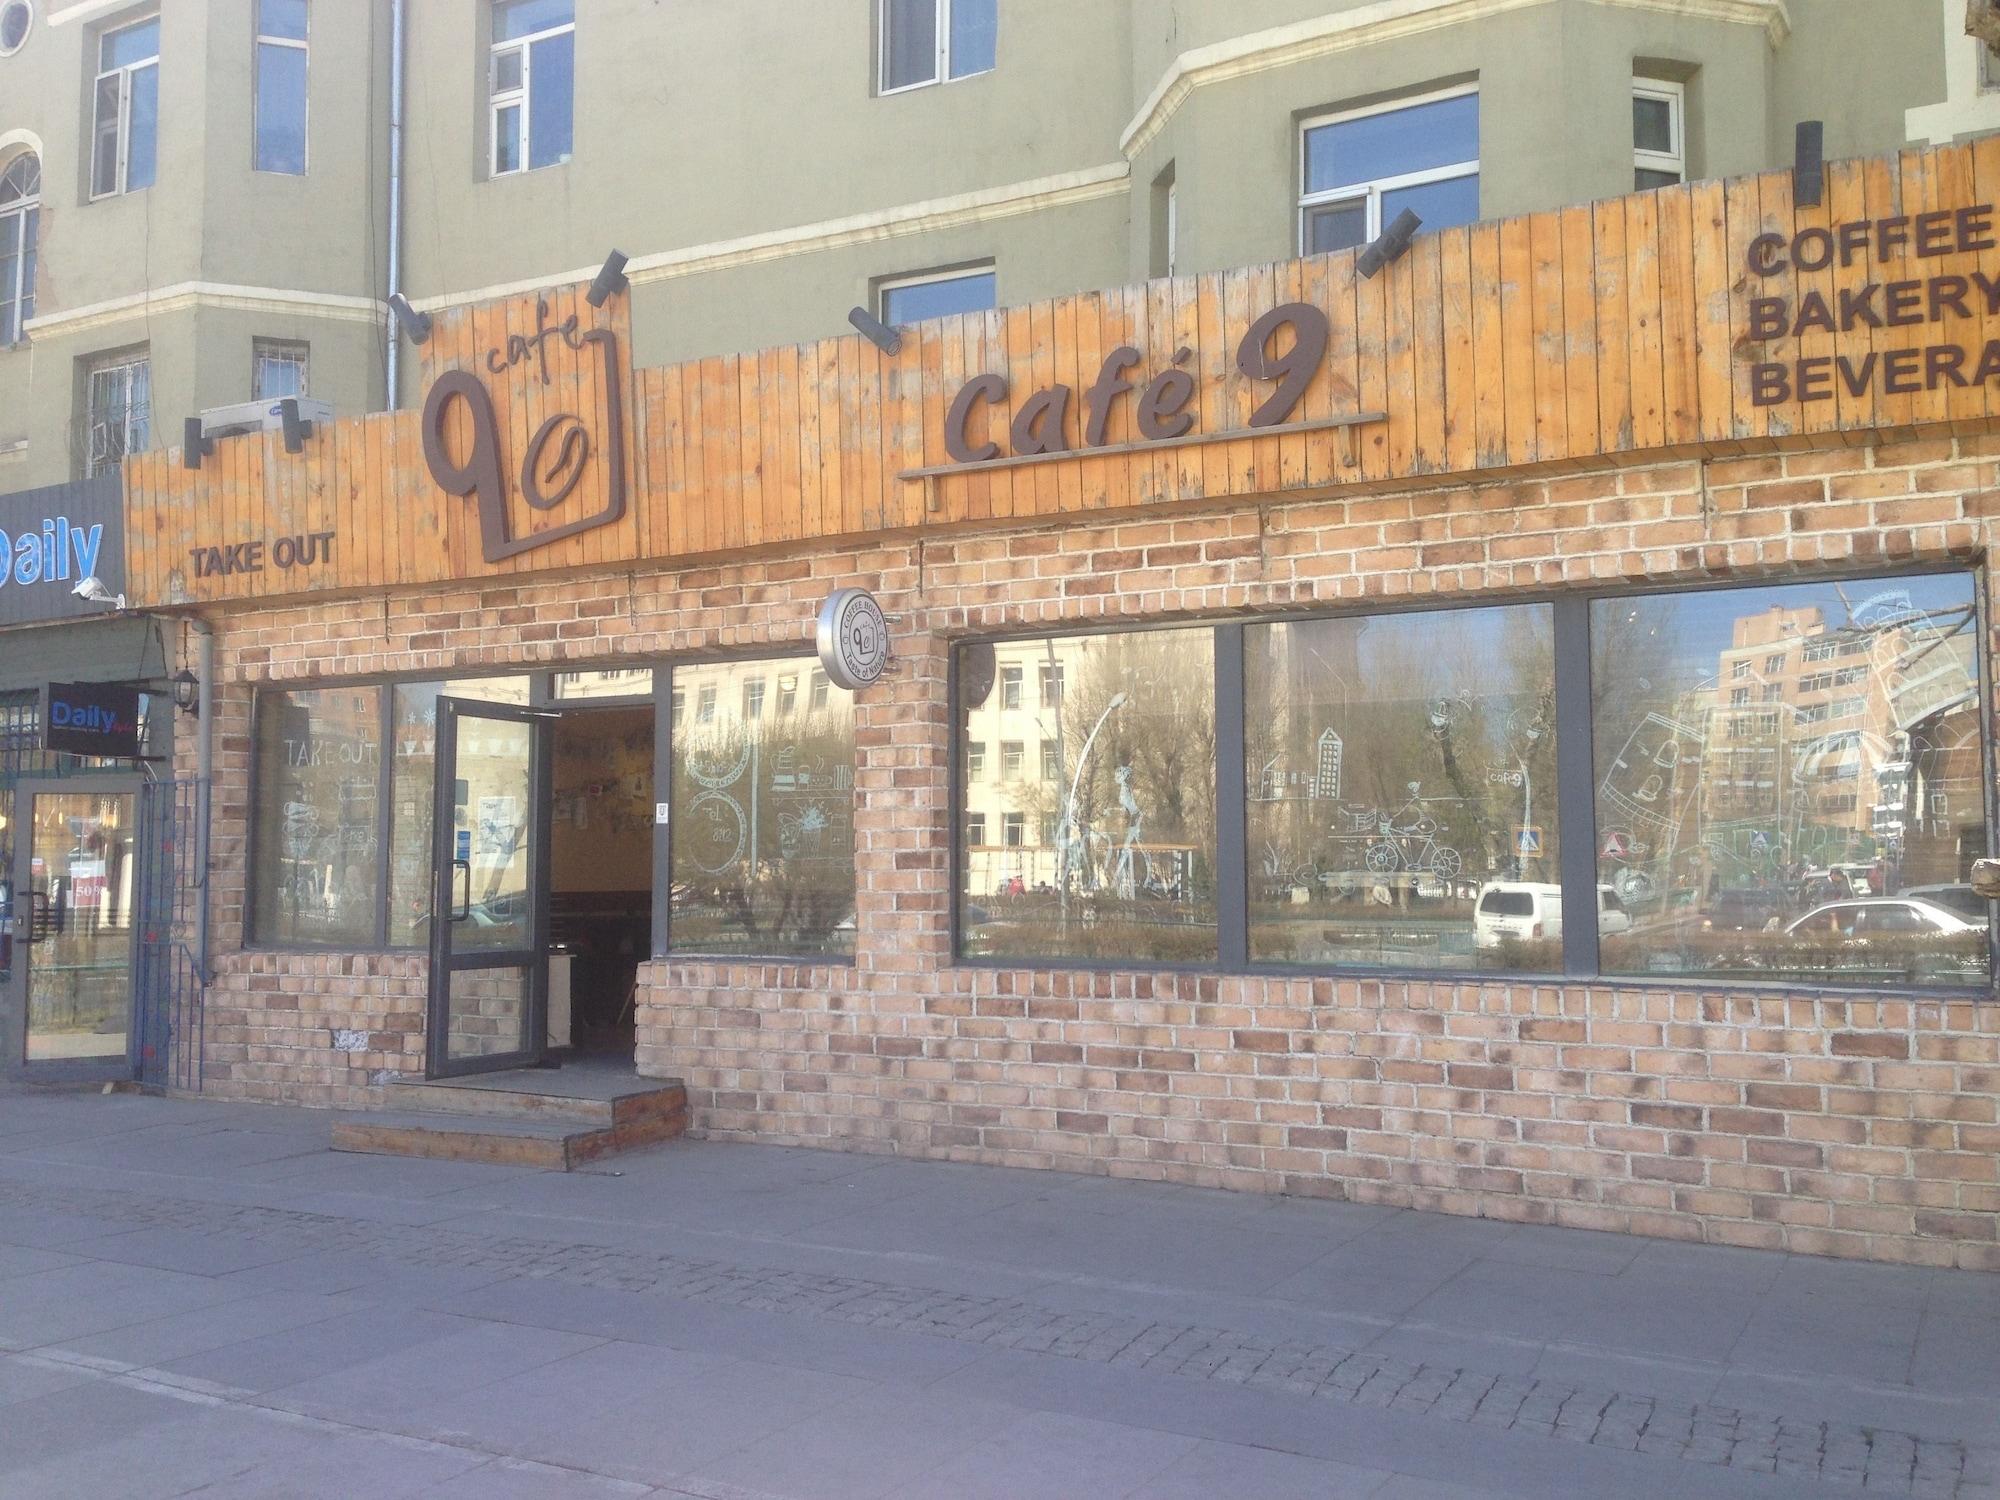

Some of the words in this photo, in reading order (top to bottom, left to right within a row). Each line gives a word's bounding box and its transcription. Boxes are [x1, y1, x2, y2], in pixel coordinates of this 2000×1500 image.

[1748, 204, 1995, 277] COFFEE
[1751, 270, 2000, 341] BAKERY
[1236, 302, 1331, 428] 9
[189, 541, 263, 578] TAKE
[273, 531, 336, 569] OUT
[844, 600, 863, 629] COFFEE
[864, 600, 883, 626] HOUSE
[846, 651, 861, 676] Taste
[862, 668, 869, 678] of
[869, 650, 885, 676] Nature
[52, 701, 116, 735] Daily
[284, 739, 335, 768] TAKE
[338, 741, 378, 764] OUT
